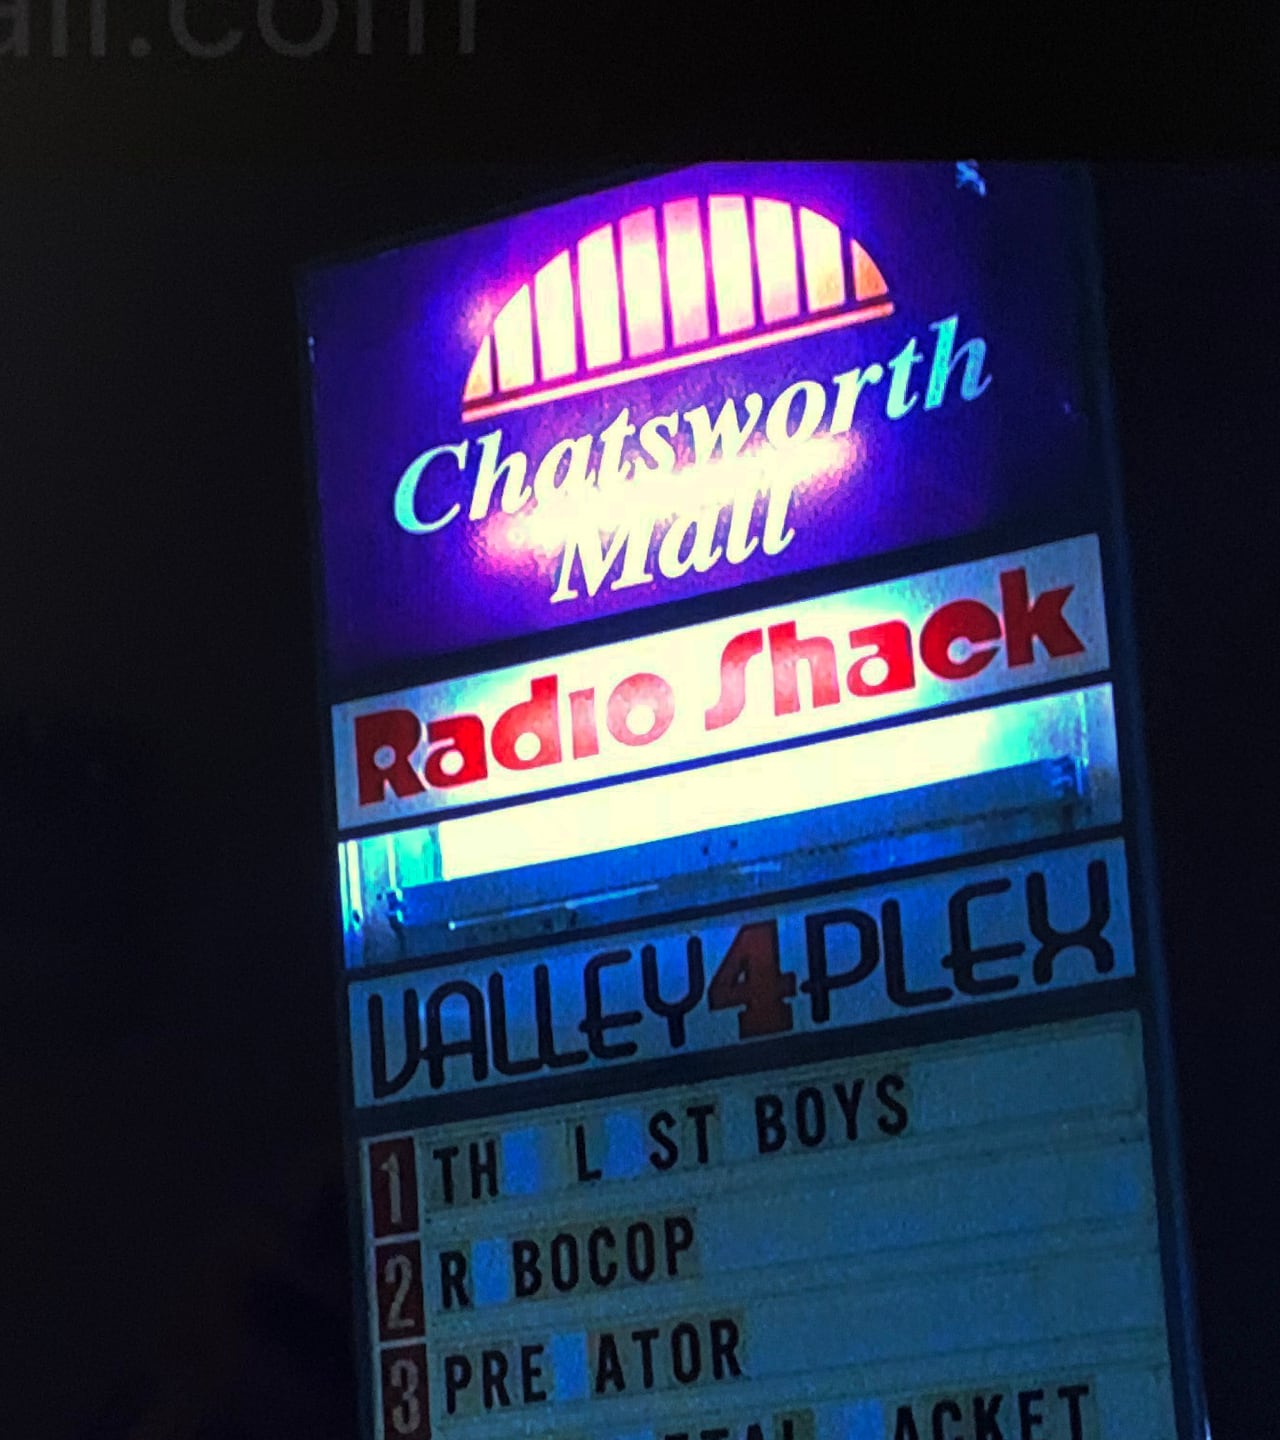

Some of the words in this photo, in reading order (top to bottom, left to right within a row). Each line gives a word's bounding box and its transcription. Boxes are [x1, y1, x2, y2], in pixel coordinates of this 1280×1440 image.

[394, 314, 993, 534] Chatsworth
[550, 482, 797, 604] Mall
[354, 673, 676, 805] Radio
[703, 568, 1086, 732] Shack
[756, 1073, 910, 1155] BOYS
